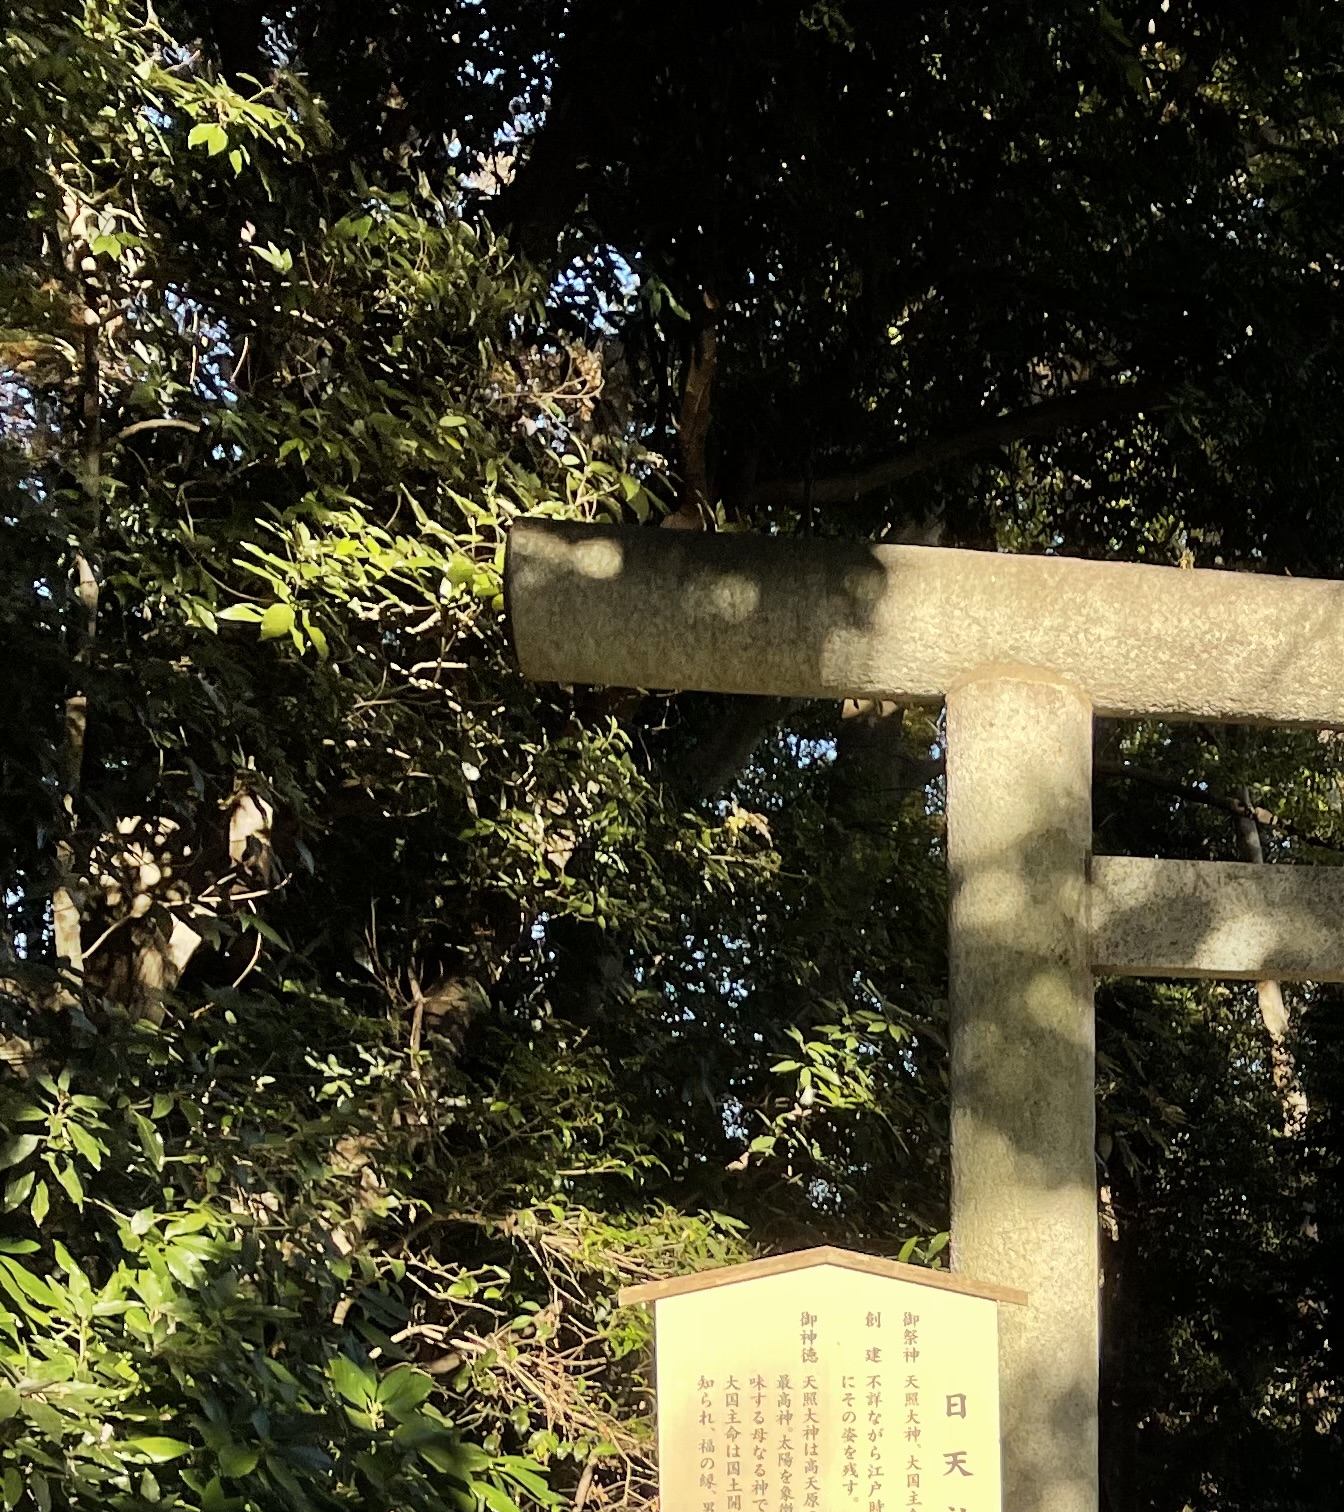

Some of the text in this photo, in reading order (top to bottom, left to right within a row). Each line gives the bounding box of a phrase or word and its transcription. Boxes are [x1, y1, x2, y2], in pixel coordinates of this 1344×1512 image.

[800, 1311, 819, 1363] 御神徳
[903, 1312, 919, 1363] 御祭神
[841, 1376, 859, 1502] にその姿を残す。
